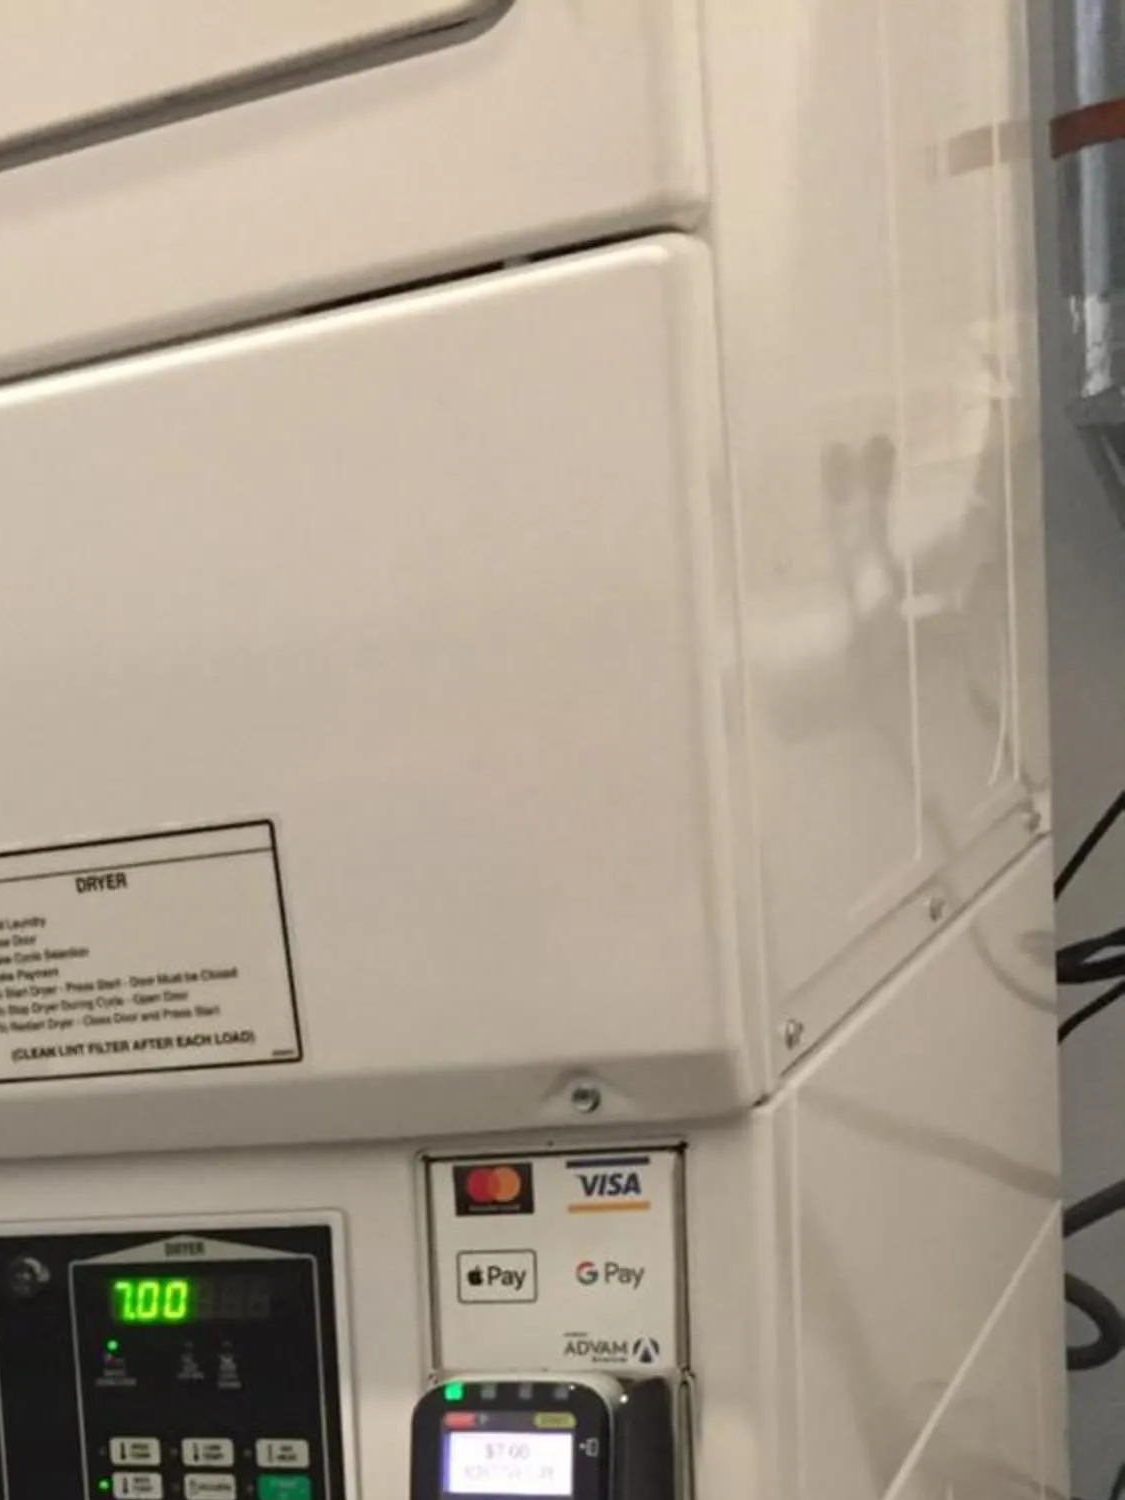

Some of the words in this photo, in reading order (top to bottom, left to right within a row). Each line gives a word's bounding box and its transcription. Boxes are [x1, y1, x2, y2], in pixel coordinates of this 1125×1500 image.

[75, 873, 128, 894] DRYER
[11, 1046, 61, 1063] (CLEAN
[60, 1043, 86, 1058] LINT
[88, 1038, 131, 1055] FILTER
[132, 1034, 174, 1052] AFTER
[176, 1031, 212, 1048] EACH
[214, 1028, 257, 1046] LOAD)
[577, 1172, 642, 1196] VISA
[487, 1265, 527, 1291] Pay
[575, 1260, 600, 1286] G
[604, 1261, 645, 1291] Pay
[113, 1279, 190, 1321] 7.00
[563, 1339, 628, 1356] ADVAM
